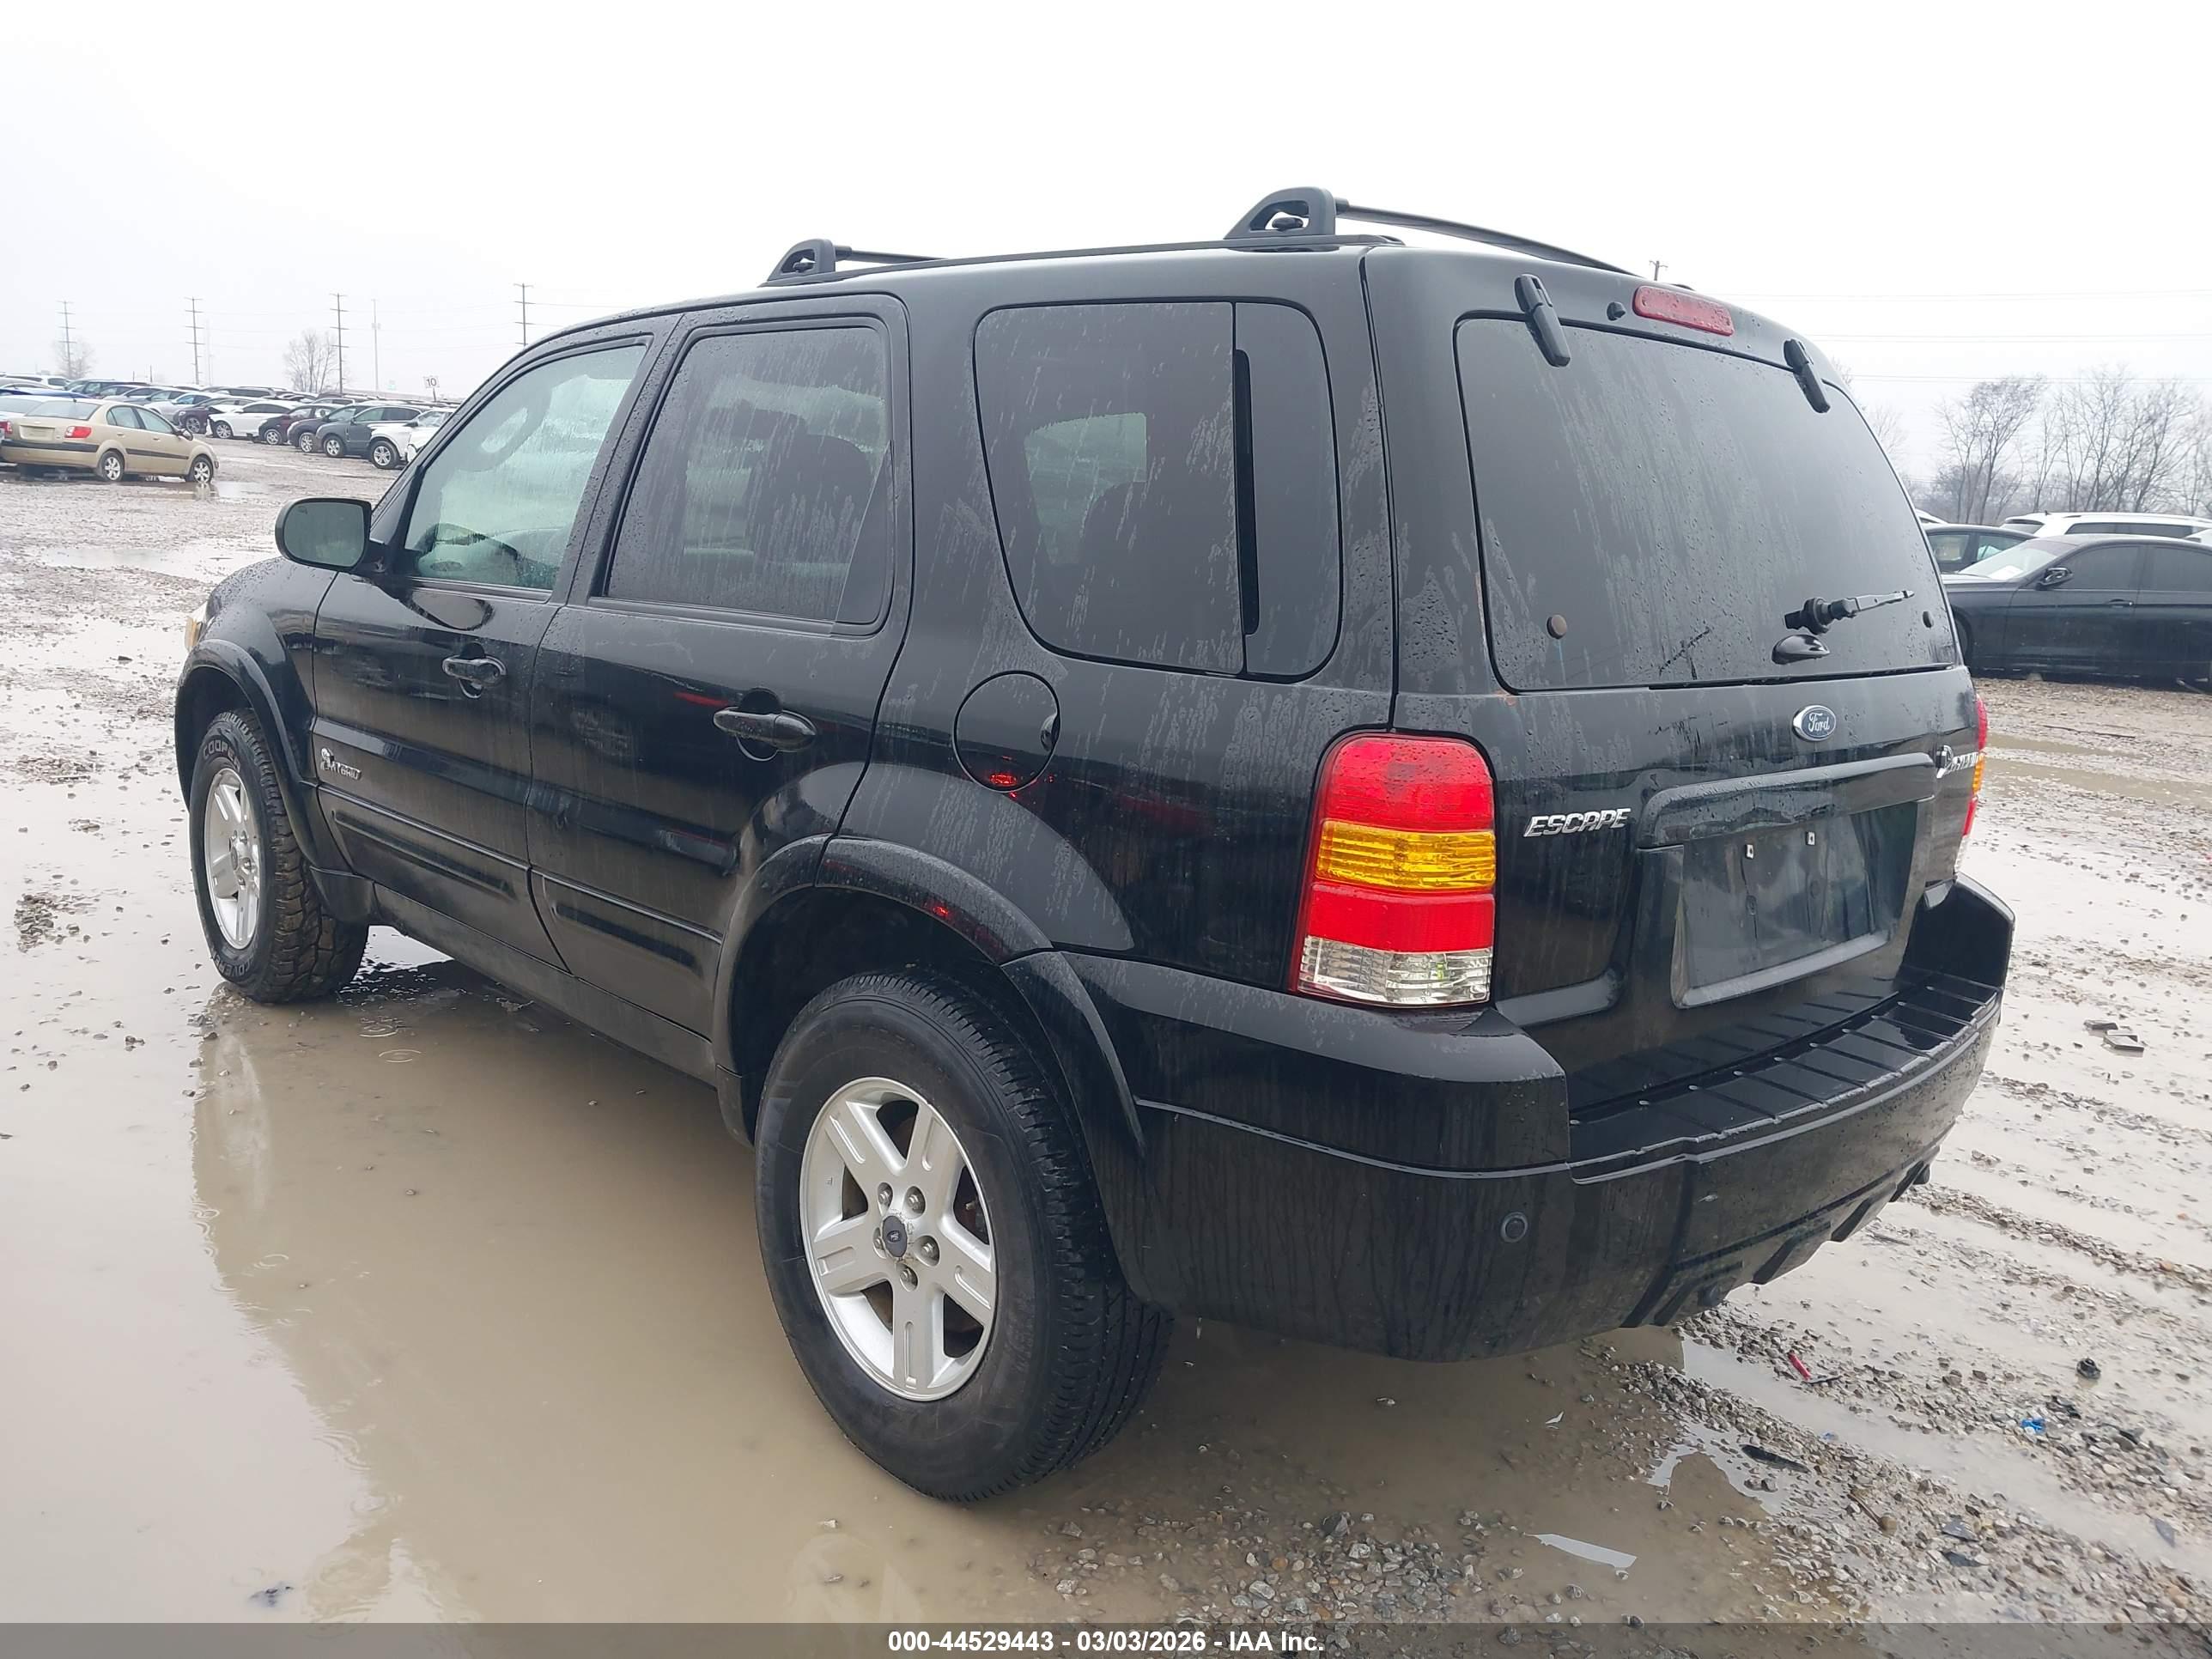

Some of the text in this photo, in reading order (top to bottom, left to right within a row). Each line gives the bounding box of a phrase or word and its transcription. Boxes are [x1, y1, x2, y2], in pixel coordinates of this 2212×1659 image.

[426, 378, 437, 386] 10
[1808, 712, 1830, 732] Ford
[203, 739, 241, 773] COOPER
[1523, 807, 1632, 837] ESCAPE
